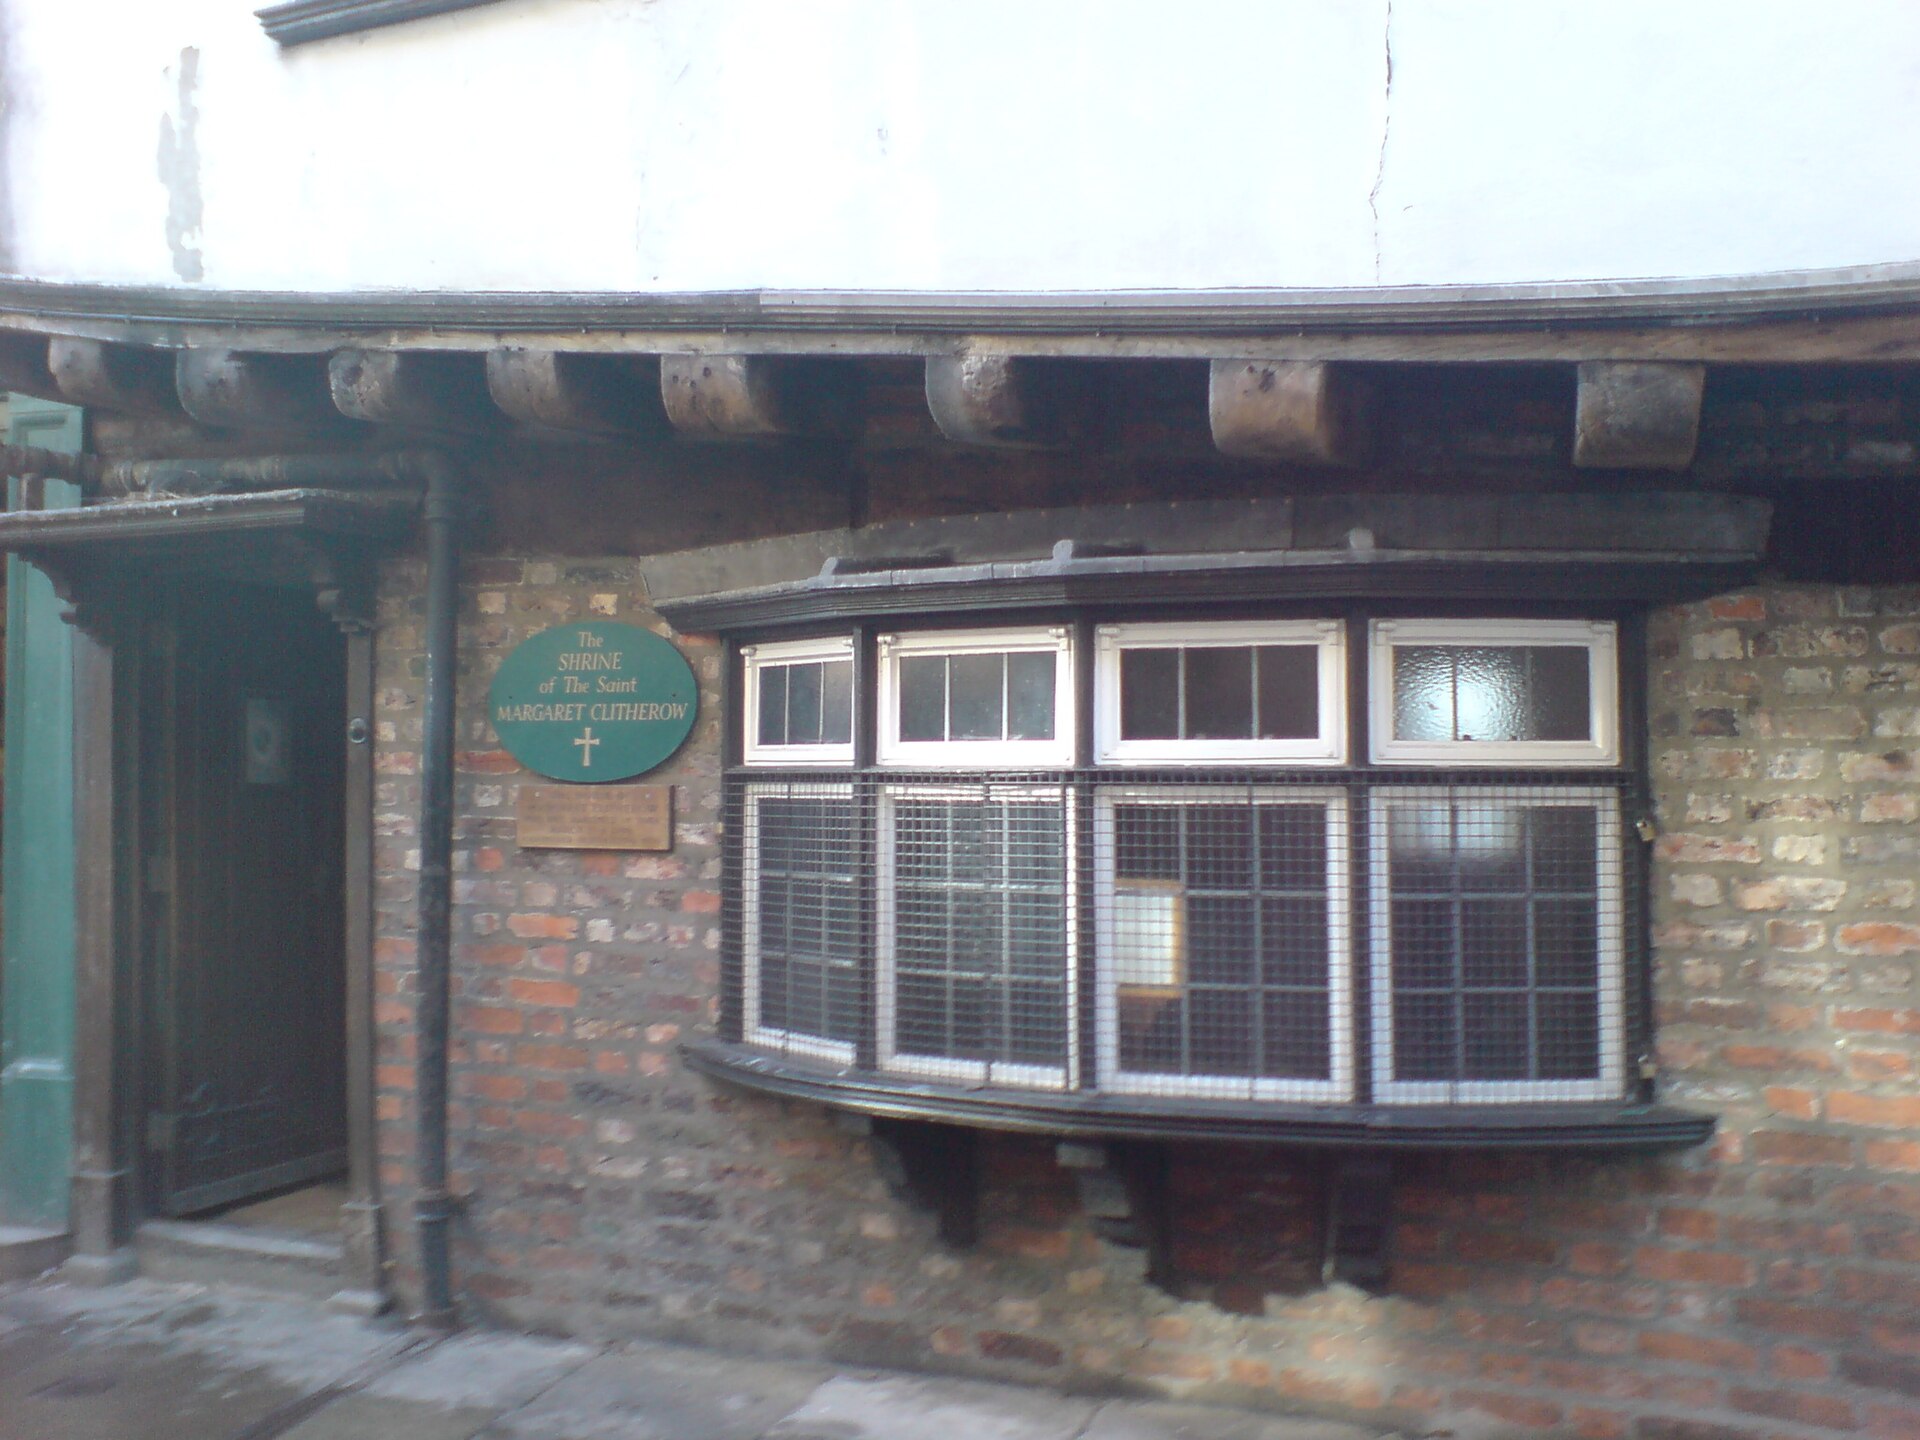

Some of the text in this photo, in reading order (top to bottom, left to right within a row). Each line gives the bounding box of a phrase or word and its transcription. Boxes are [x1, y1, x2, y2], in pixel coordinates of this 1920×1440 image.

[578, 631, 604, 648] The
[558, 652, 623, 671] SHRINE
[539, 676, 638, 694] of The Saint
[497, 702, 688, 721] MARGARET CLITHEROW
